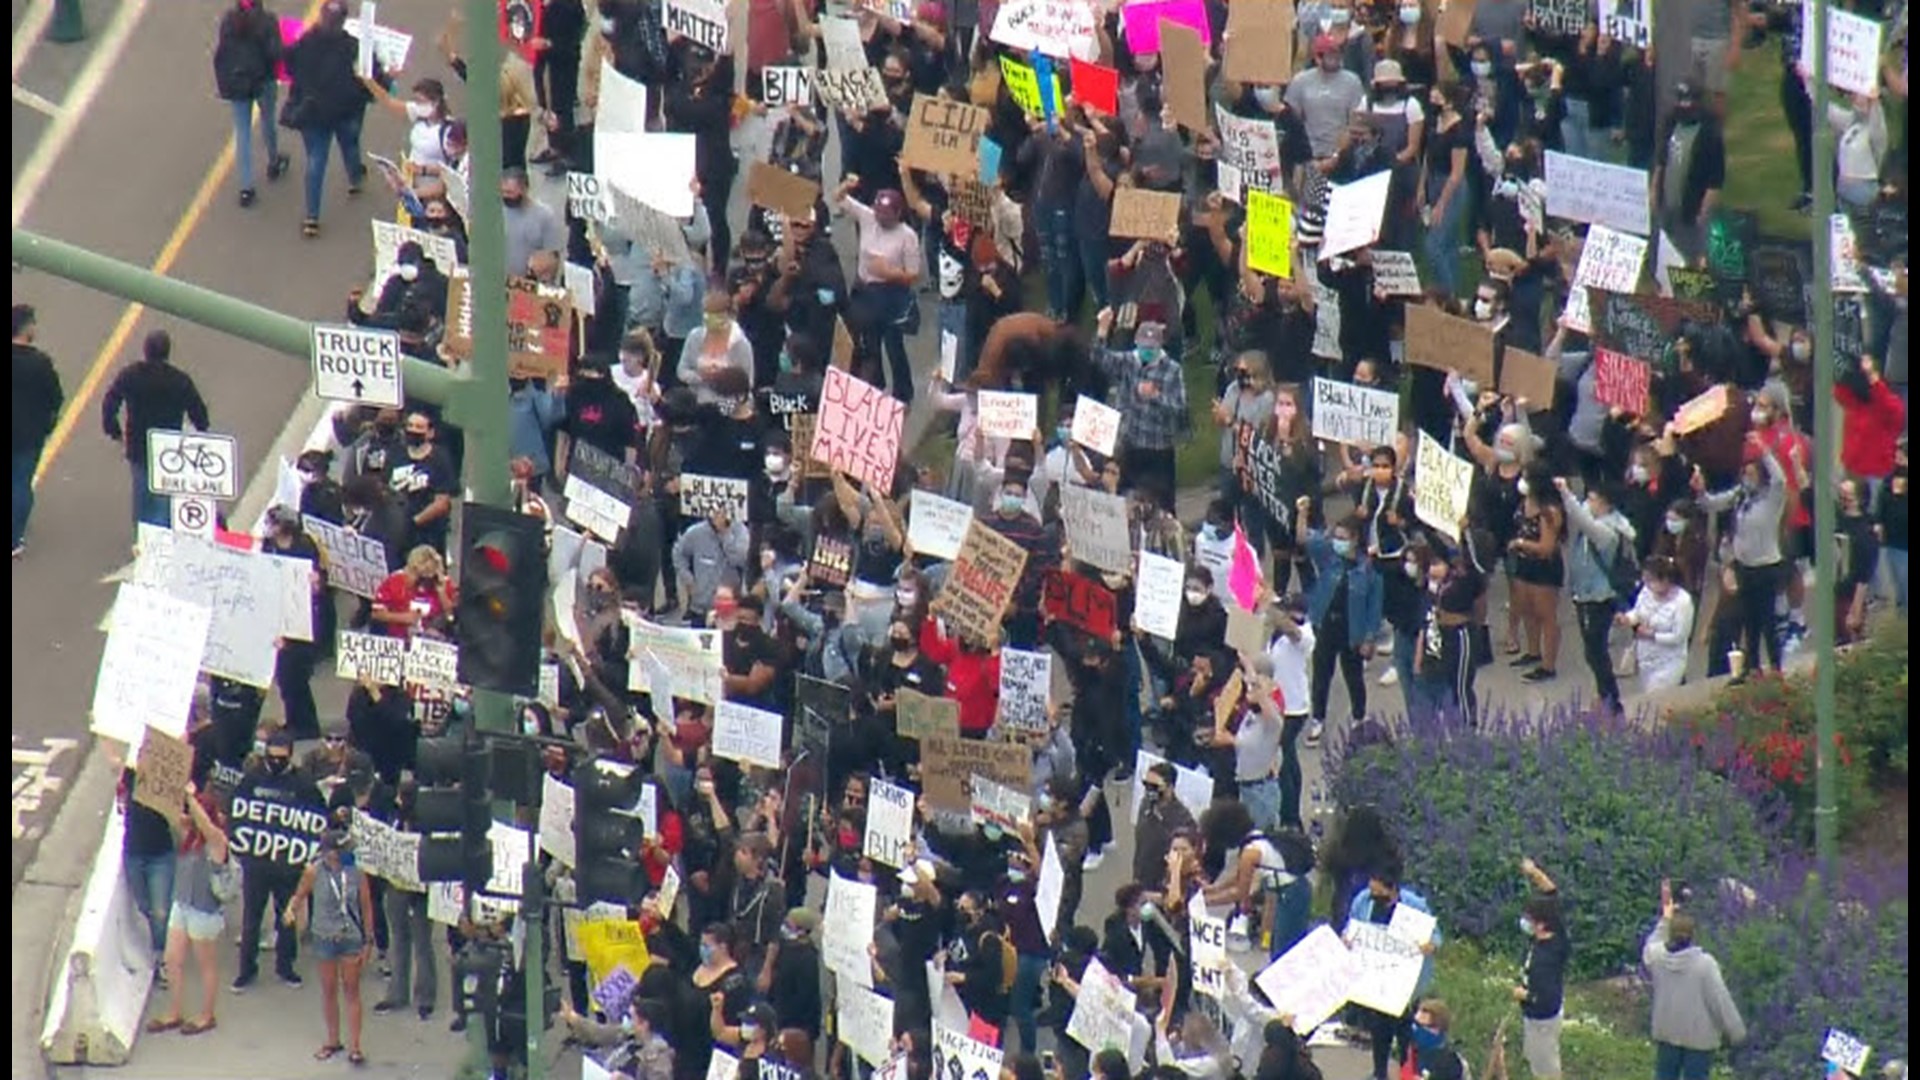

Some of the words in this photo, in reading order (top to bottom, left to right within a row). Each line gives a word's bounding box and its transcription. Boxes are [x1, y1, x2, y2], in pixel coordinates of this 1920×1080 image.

[666, 3, 725, 51] MATTER
[568, 176, 599, 196] NO
[318, 331, 394, 358] TRUCK
[320, 355, 395, 380] ROUTE
[770, 393, 808, 415] Black
[825, 370, 906, 438] BLACK
[1318, 381, 1359, 413] Black
[822, 403, 897, 473] LIVES
[1321, 409, 1390, 443] MATTER
[813, 438, 891, 493] MATTER
[160, 476, 188, 490] BIKE
[193, 479, 224, 493] LANE
[339, 652, 400, 681] MATTER
[232, 797, 327, 834] DEFUND
[229, 826, 322, 865] SDPD!
[868, 829, 908, 865] BLM
